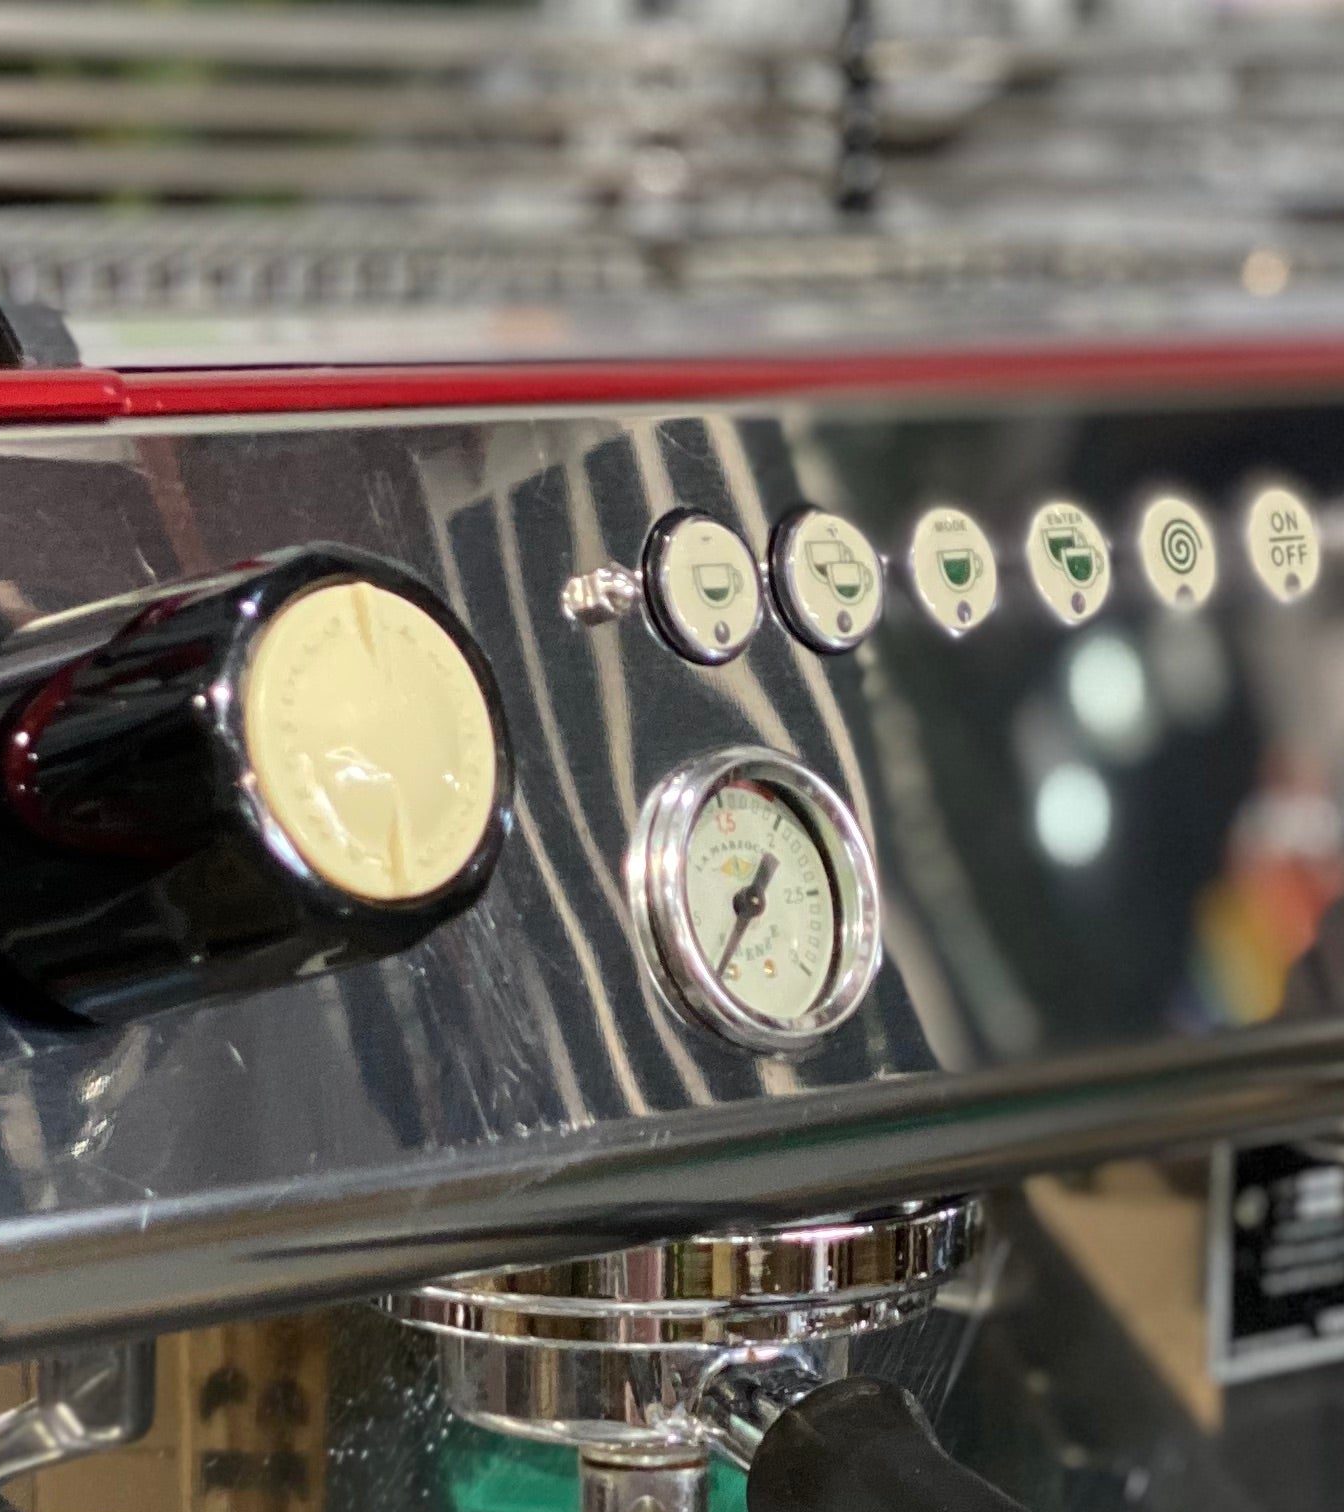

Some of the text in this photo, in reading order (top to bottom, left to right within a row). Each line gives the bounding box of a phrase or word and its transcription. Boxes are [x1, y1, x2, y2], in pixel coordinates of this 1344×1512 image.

[934, 519, 968, 532] MODE
[1046, 512, 1083, 525] ENTER
[1270, 511, 1299, 533] ON
[1270, 543, 1308, 567] OFF
